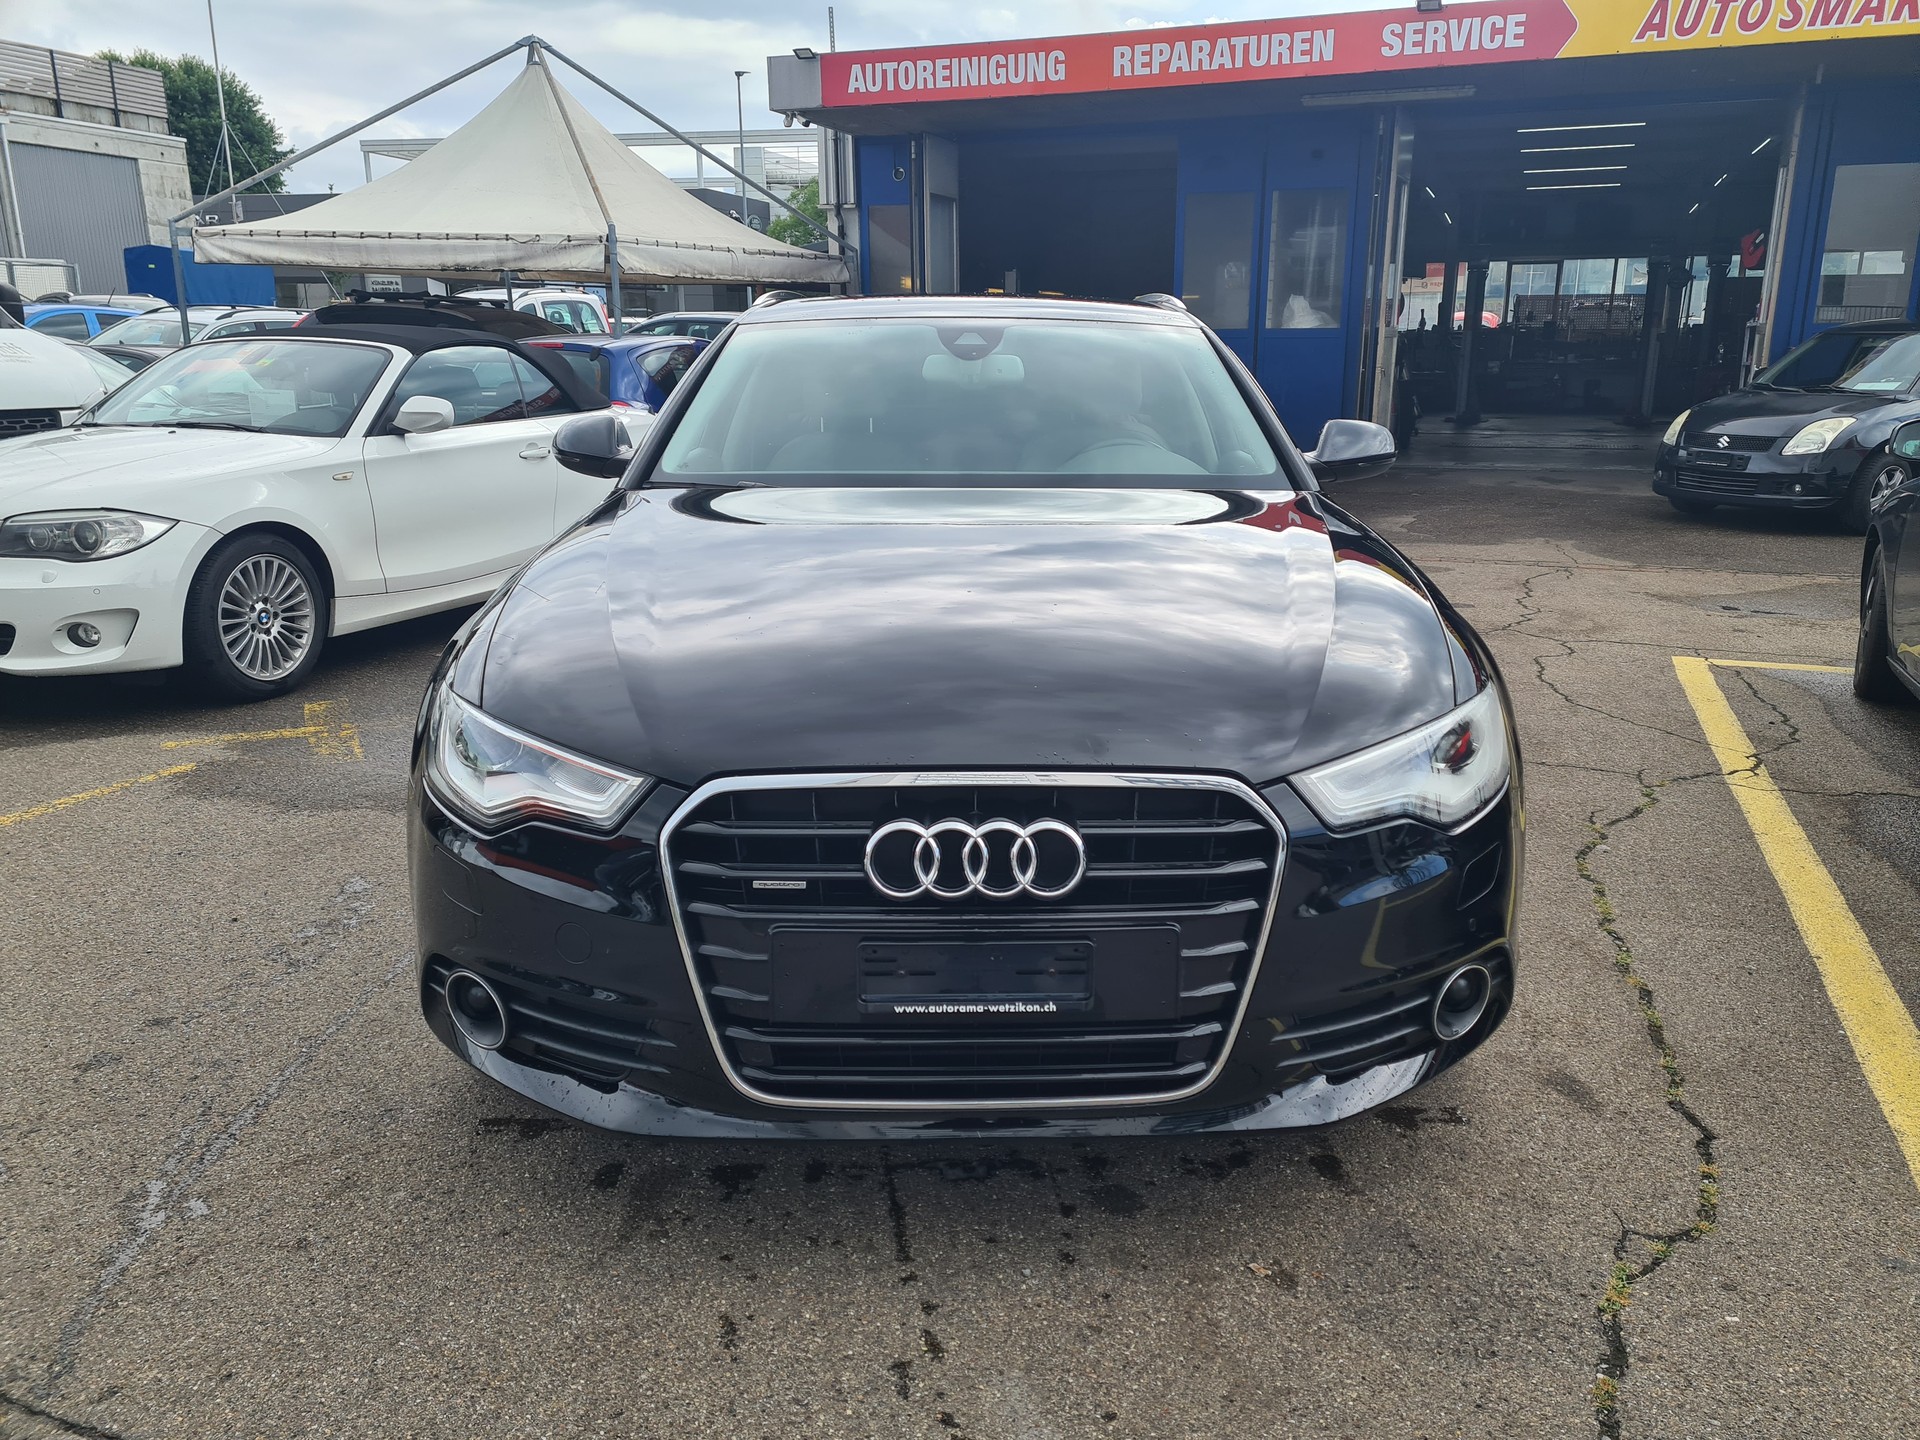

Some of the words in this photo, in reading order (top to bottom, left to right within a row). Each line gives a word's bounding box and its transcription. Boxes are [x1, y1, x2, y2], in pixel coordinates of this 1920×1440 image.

[1631, 0, 1776, 42] AUTO
[847, 50, 1066, 93] AUTOREINIGUNG
[1113, 29, 1335, 77] REPARATUREN
[1381, 13, 1527, 57] SERVICE
[893, 1001, 1057, 1013] www.autorama-wetzikon.ch
